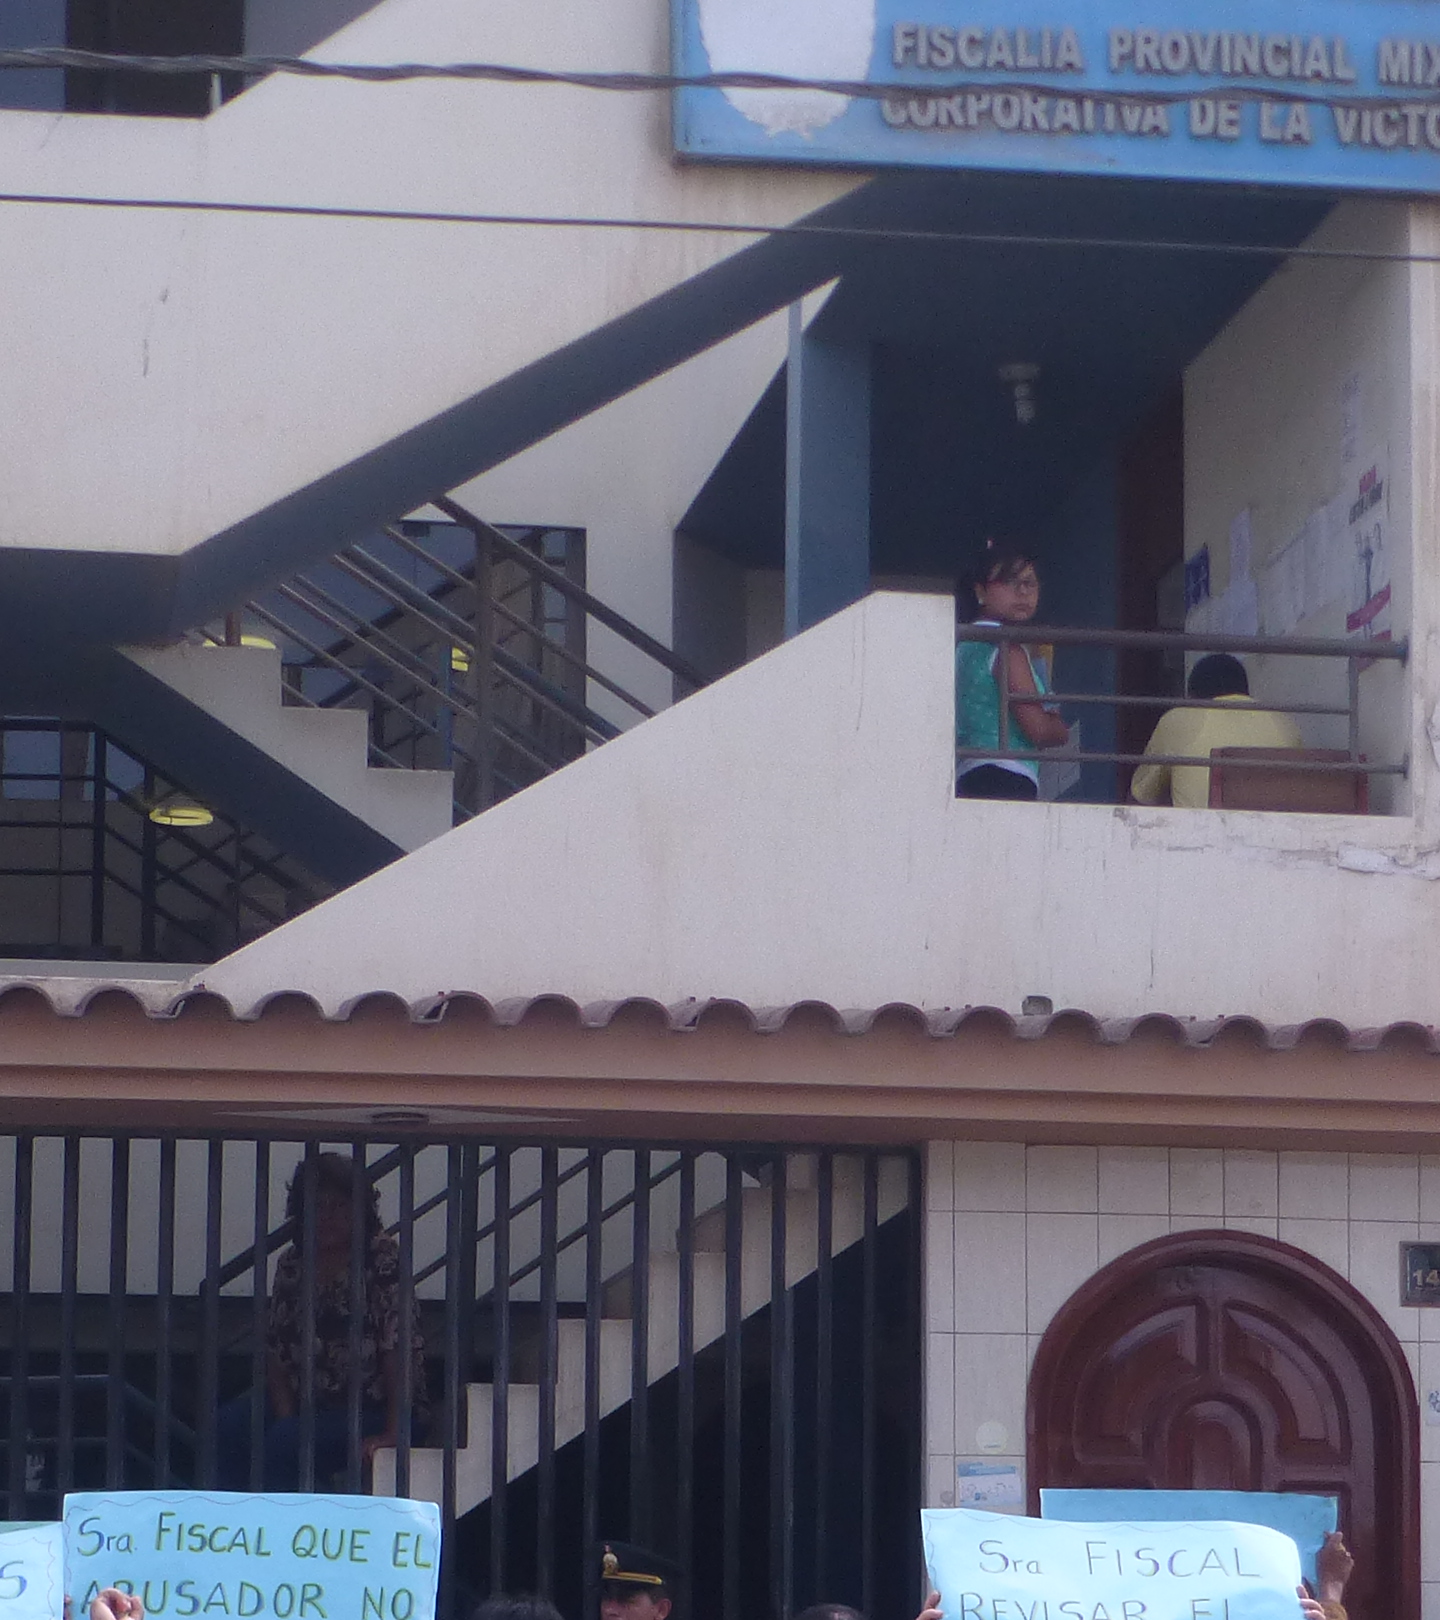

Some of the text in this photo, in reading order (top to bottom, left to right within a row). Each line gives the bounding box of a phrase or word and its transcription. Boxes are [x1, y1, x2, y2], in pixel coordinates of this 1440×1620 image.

[892, 22, 1085, 74] FISCALIA
[1107, 27, 1356, 85] PROVINCIAL
[1188, 97, 1242, 140] DE
[1259, 100, 1312, 145] LA
[155, 1511, 271, 1556] FISCAL
[291, 1524, 370, 1563] QUE
[392, 1531, 433, 1569] EL
[1085, 1539, 1261, 1578] FISCAL
